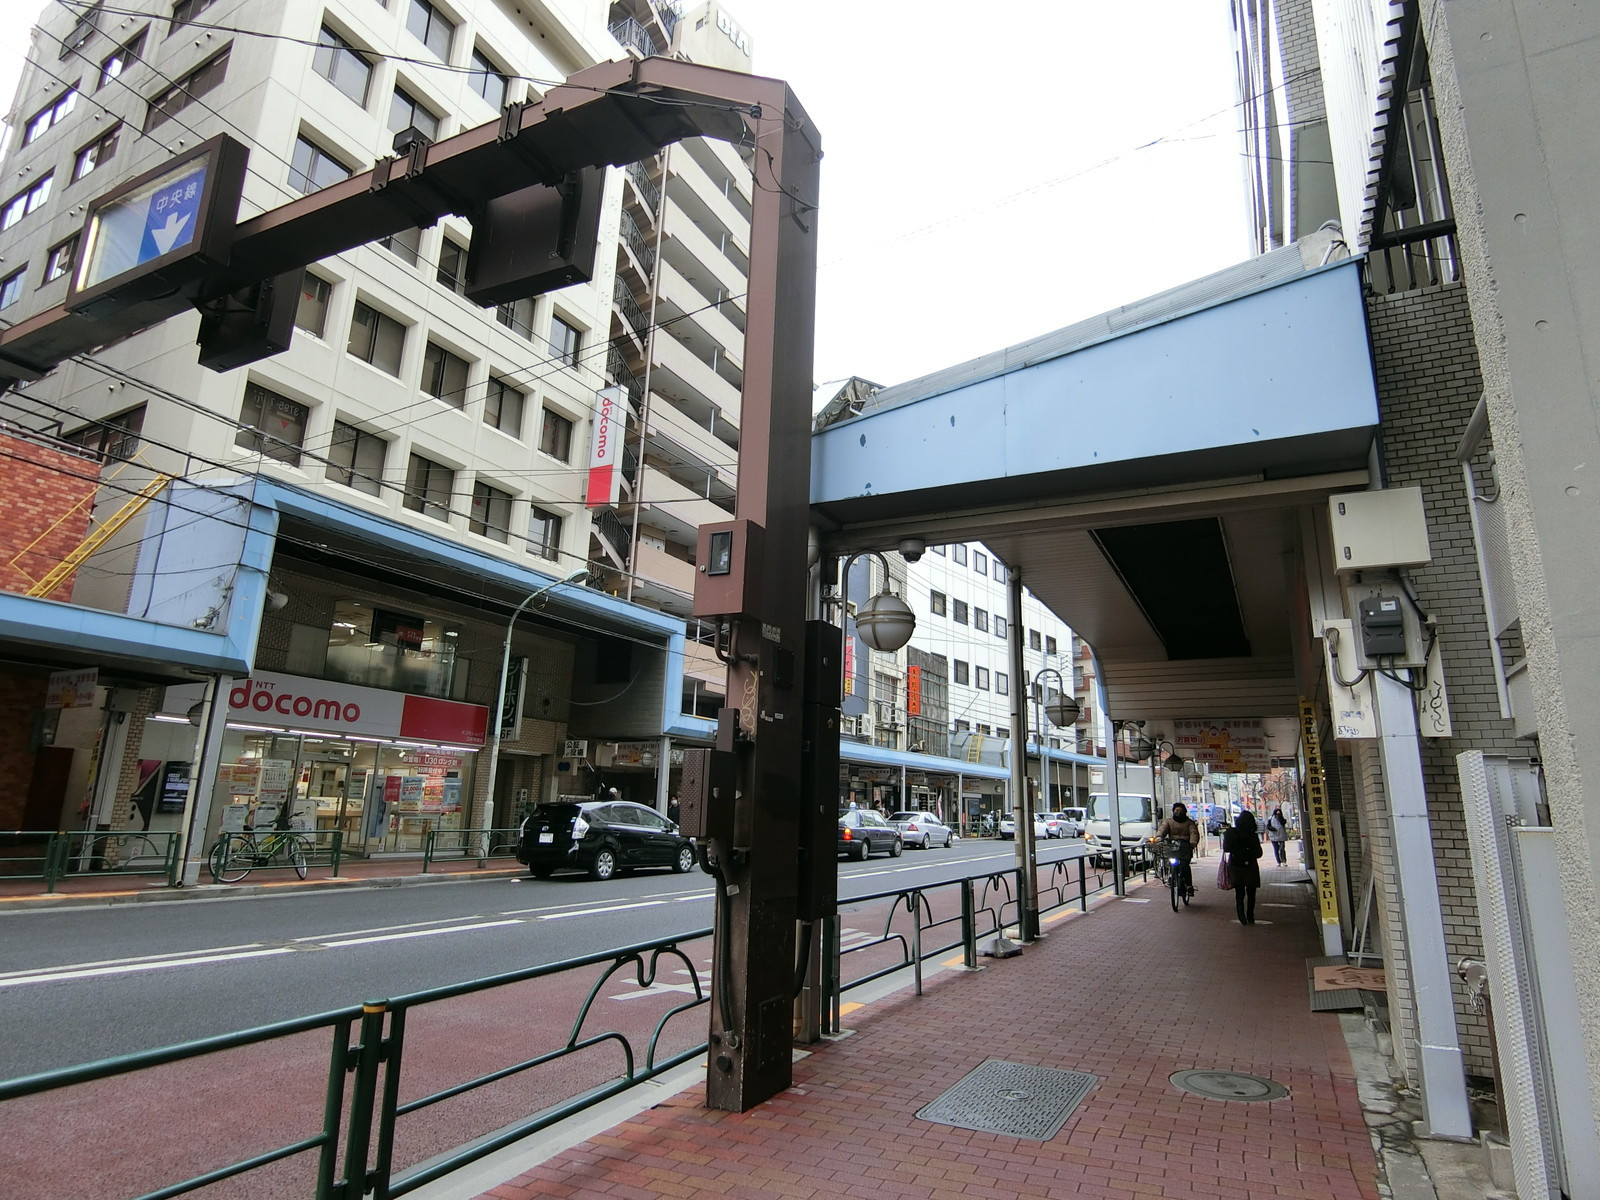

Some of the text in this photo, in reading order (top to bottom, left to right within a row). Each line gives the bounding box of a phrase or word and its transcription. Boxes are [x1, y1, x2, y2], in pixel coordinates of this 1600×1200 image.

[156, 181, 199, 214] 中央線
[598, 397, 613, 459] docomo
[229, 680, 361, 723] docomo
[255, 680, 276, 690] NTT
[500, 729, 512, 739] 6F
